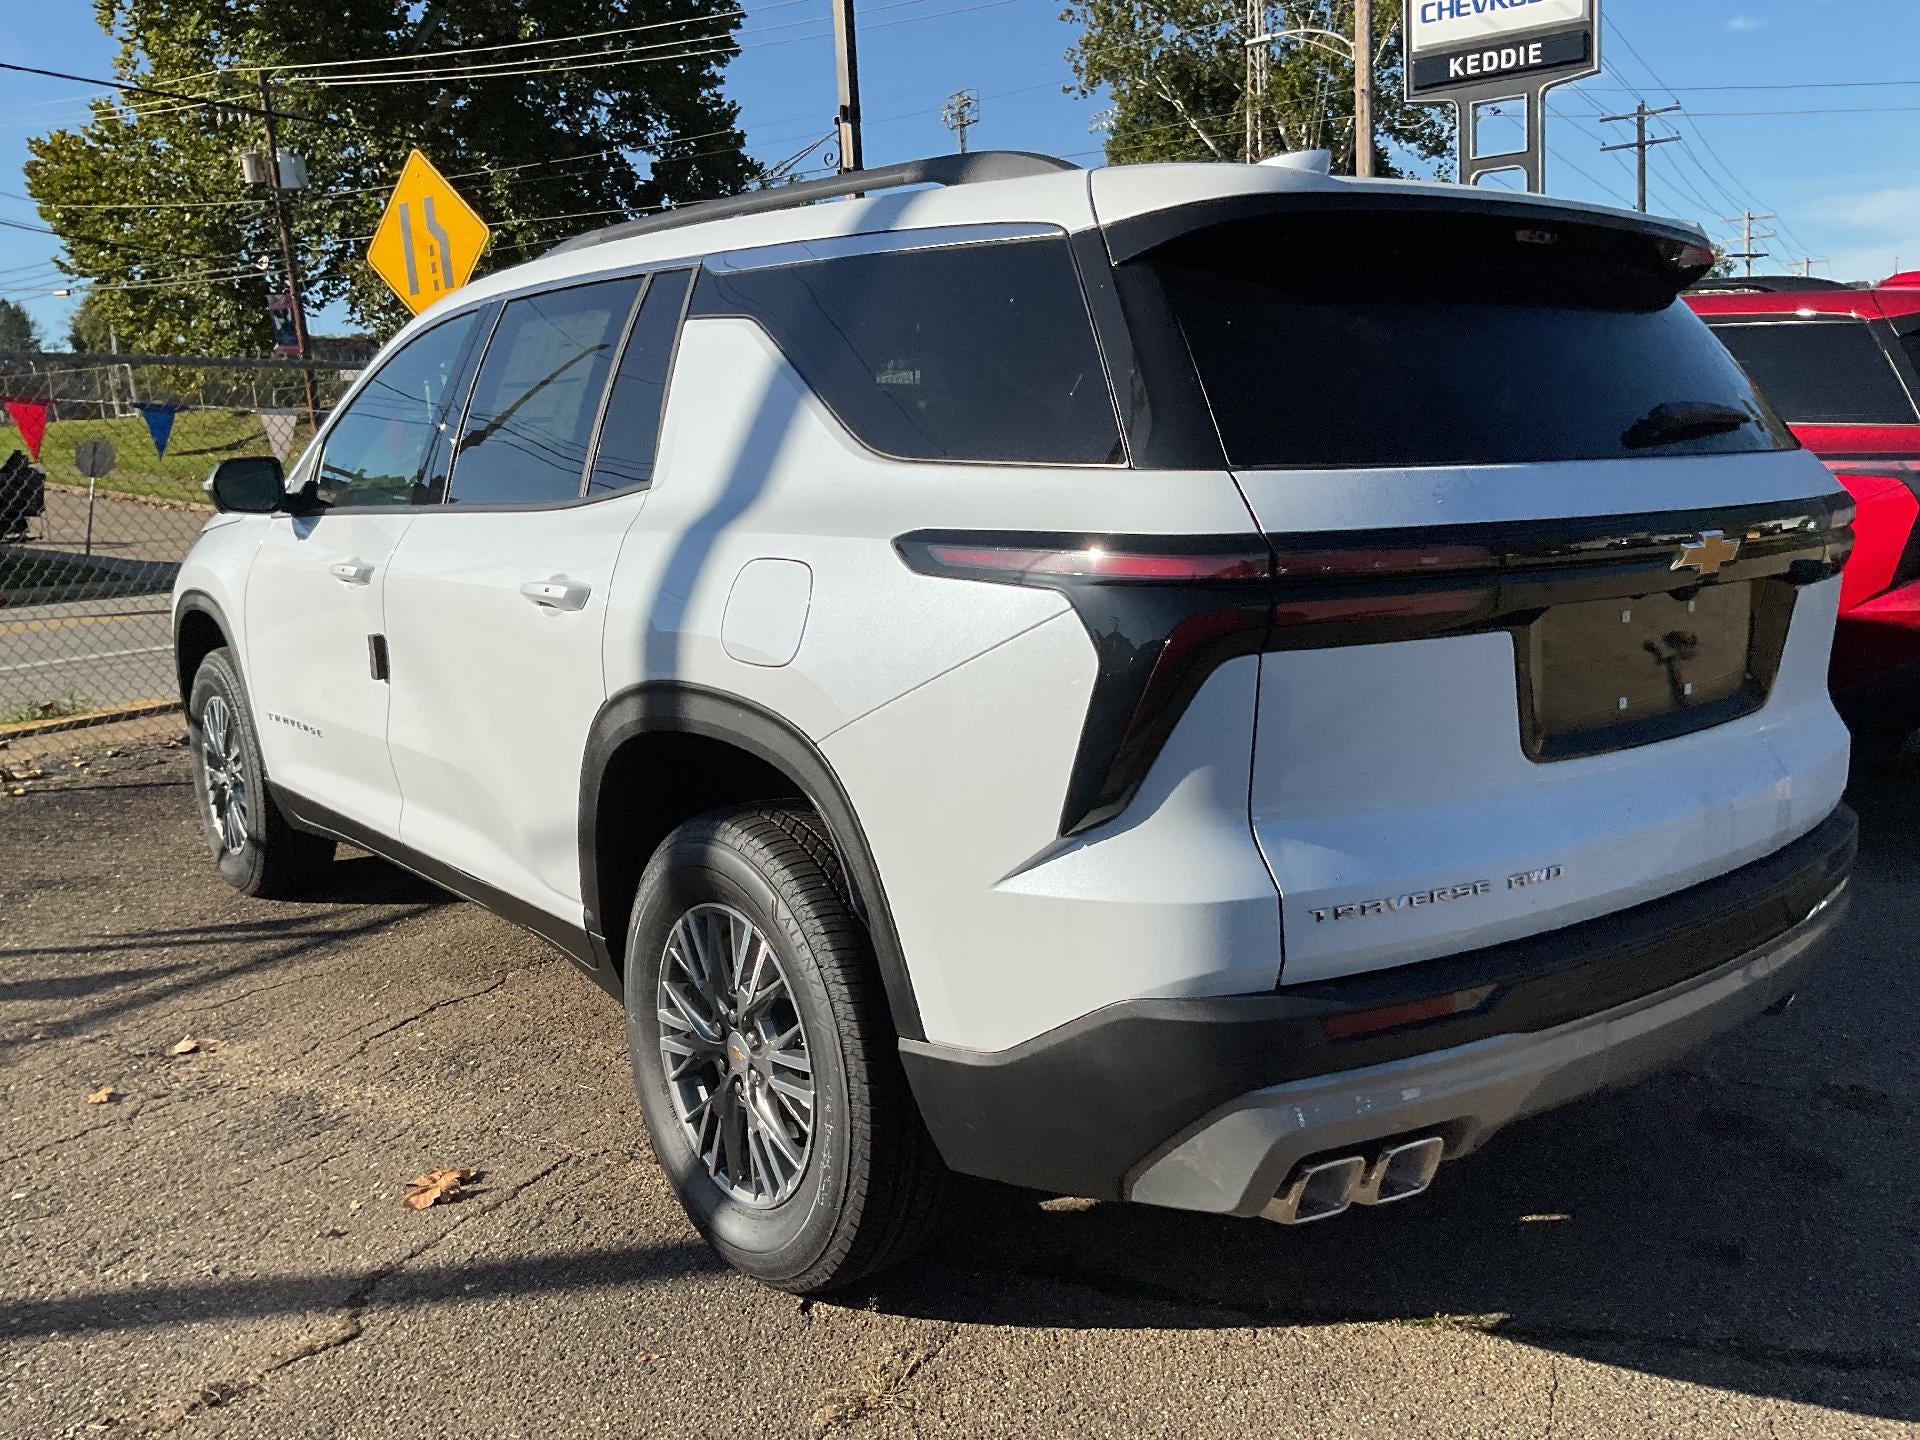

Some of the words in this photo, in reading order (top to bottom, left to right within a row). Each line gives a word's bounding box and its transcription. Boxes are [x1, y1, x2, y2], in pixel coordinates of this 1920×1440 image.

[1449, 43, 1543, 78] KEDDIE
[267, 712, 324, 738] TRAVERSE
[1308, 879, 1491, 923] TRAVERSE
[1507, 863, 1563, 889] AWD
